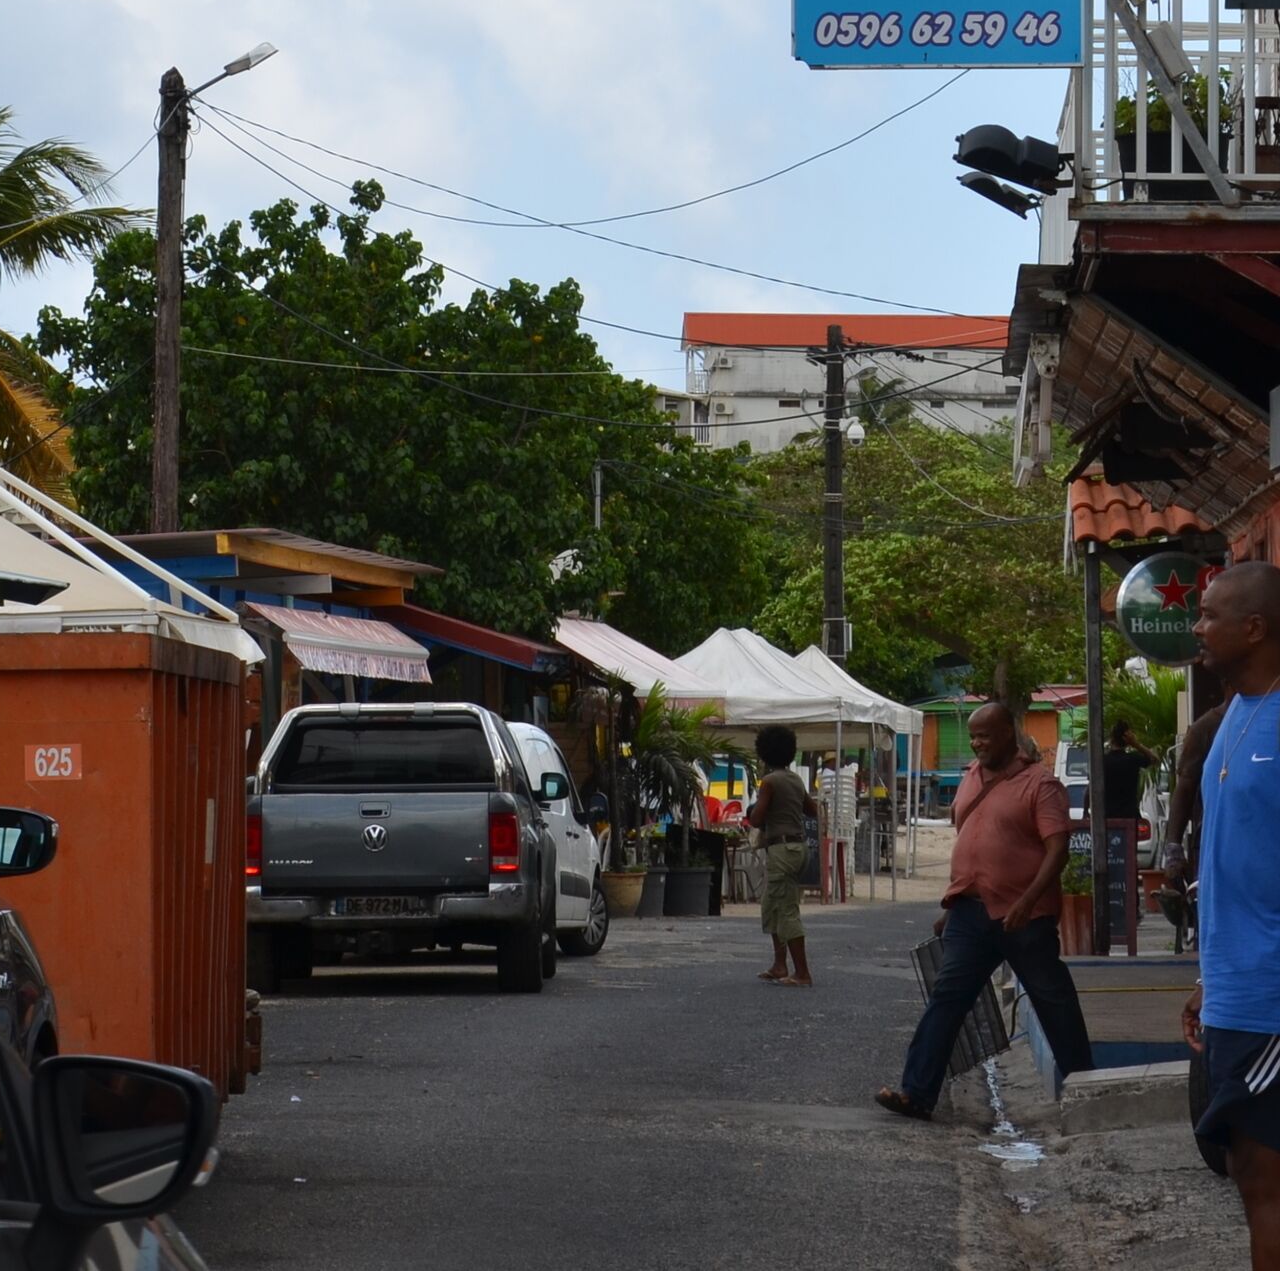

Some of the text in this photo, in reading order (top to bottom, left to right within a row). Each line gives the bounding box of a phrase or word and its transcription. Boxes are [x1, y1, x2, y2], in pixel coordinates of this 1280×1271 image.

[813, 11, 1061, 49] 0596 62 59 46
[1130, 617, 1195, 633] Heinek
[34, 747, 72, 777] 625
